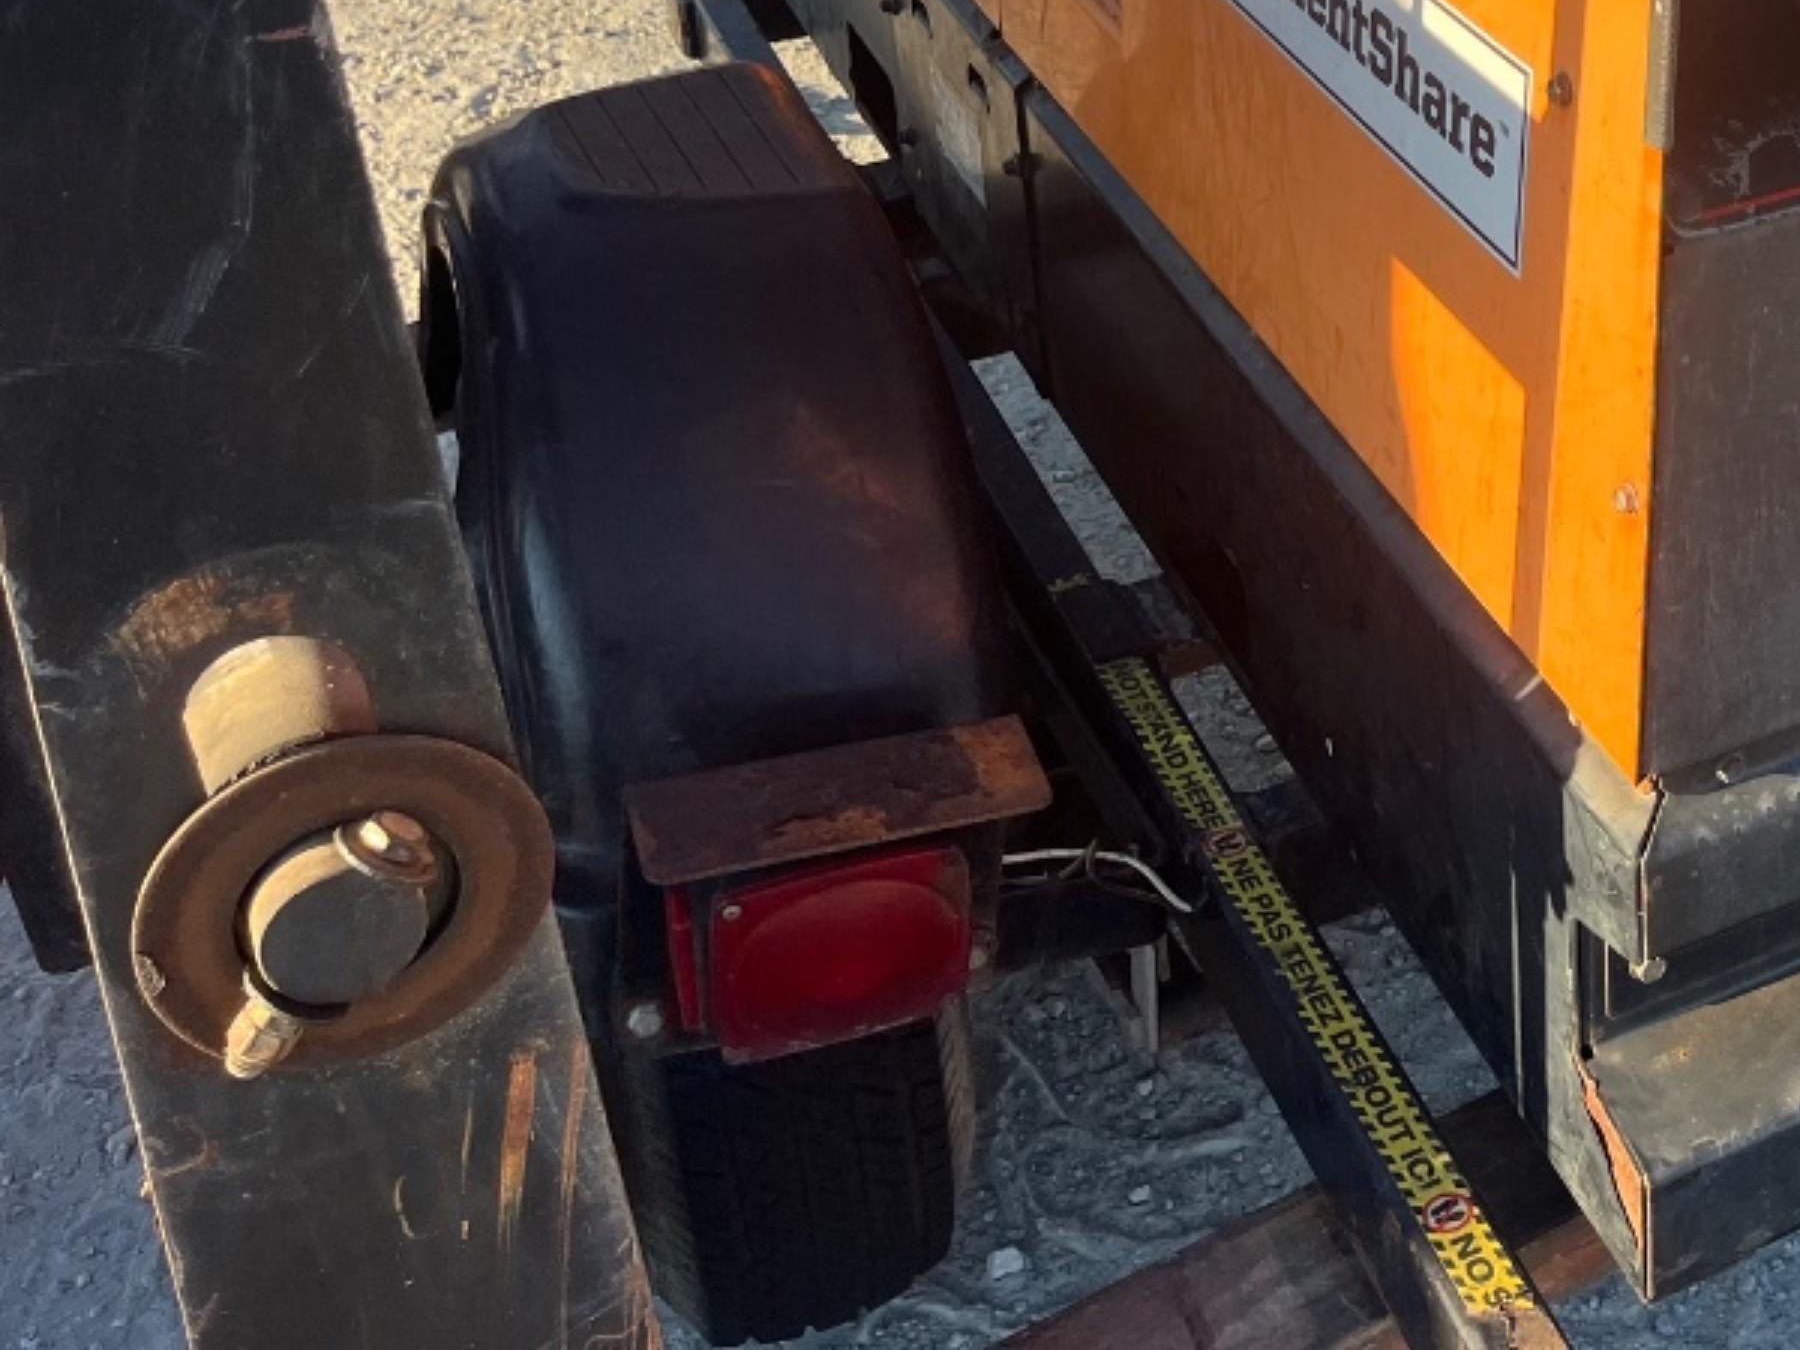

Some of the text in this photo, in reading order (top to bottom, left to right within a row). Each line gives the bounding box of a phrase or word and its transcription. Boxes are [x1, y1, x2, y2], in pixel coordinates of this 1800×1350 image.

[1174, 768, 1229, 831] HERE
[1227, 859, 1442, 1191] NE PAS TENEZ DEBOUT ICI
[1449, 1231, 1496, 1285] NO
